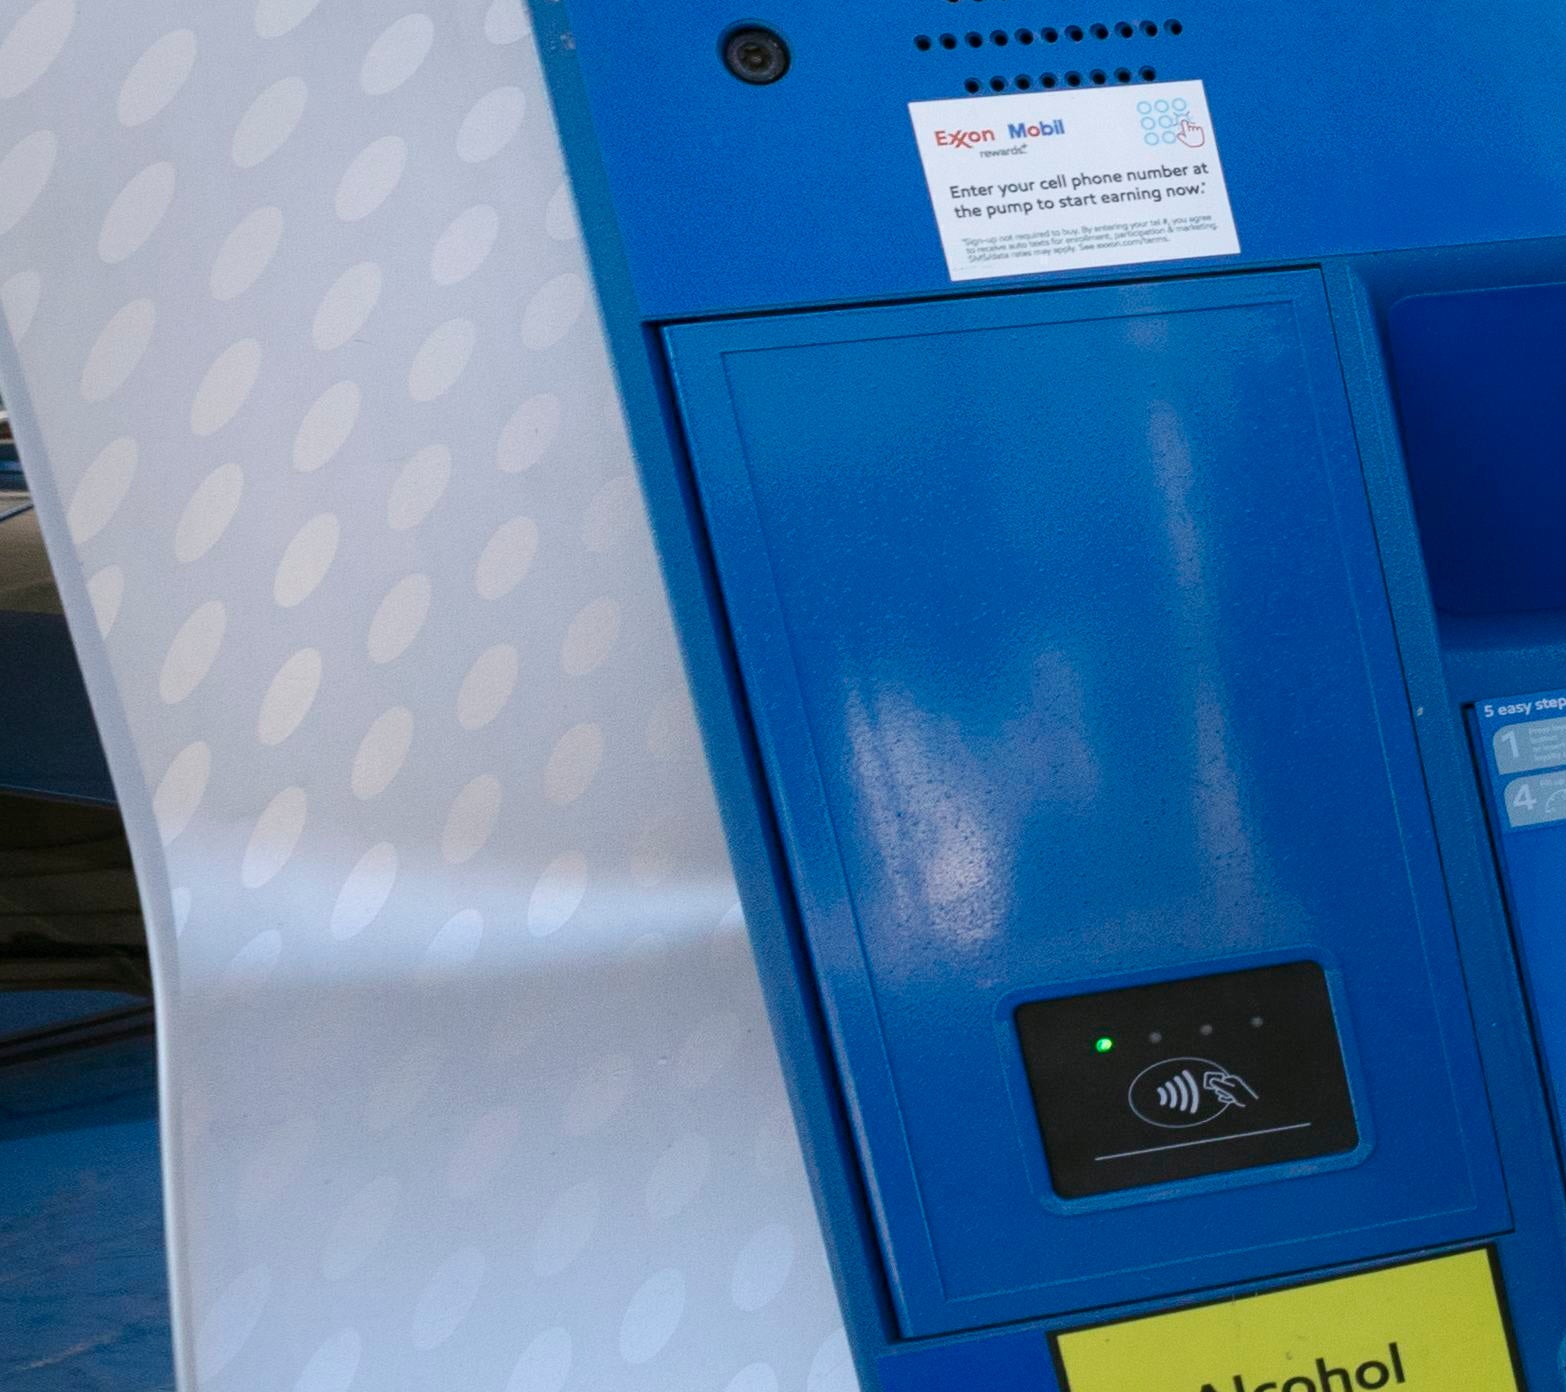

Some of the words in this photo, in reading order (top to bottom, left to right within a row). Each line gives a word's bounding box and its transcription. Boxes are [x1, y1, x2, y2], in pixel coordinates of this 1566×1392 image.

[935, 127, 995, 149] Exxon
[1008, 119, 1065, 139] Mobil
[950, 184, 993, 199] Enter
[998, 181, 1034, 199] your
[1040, 175, 1067, 190] cell
[1072, 170, 1122, 189] phone
[1127, 164, 1188, 183] number
[1193, 162, 1208, 175] at
[954, 204, 982, 219] the
[986, 201, 1033, 219] pump
[1037, 198, 1054, 210] to
[1058, 192, 1097, 208] start
[1101, 187, 1161, 206] earning
[1485, 705, 1494, 719] 5
[1498, 699, 1532, 719] easy
